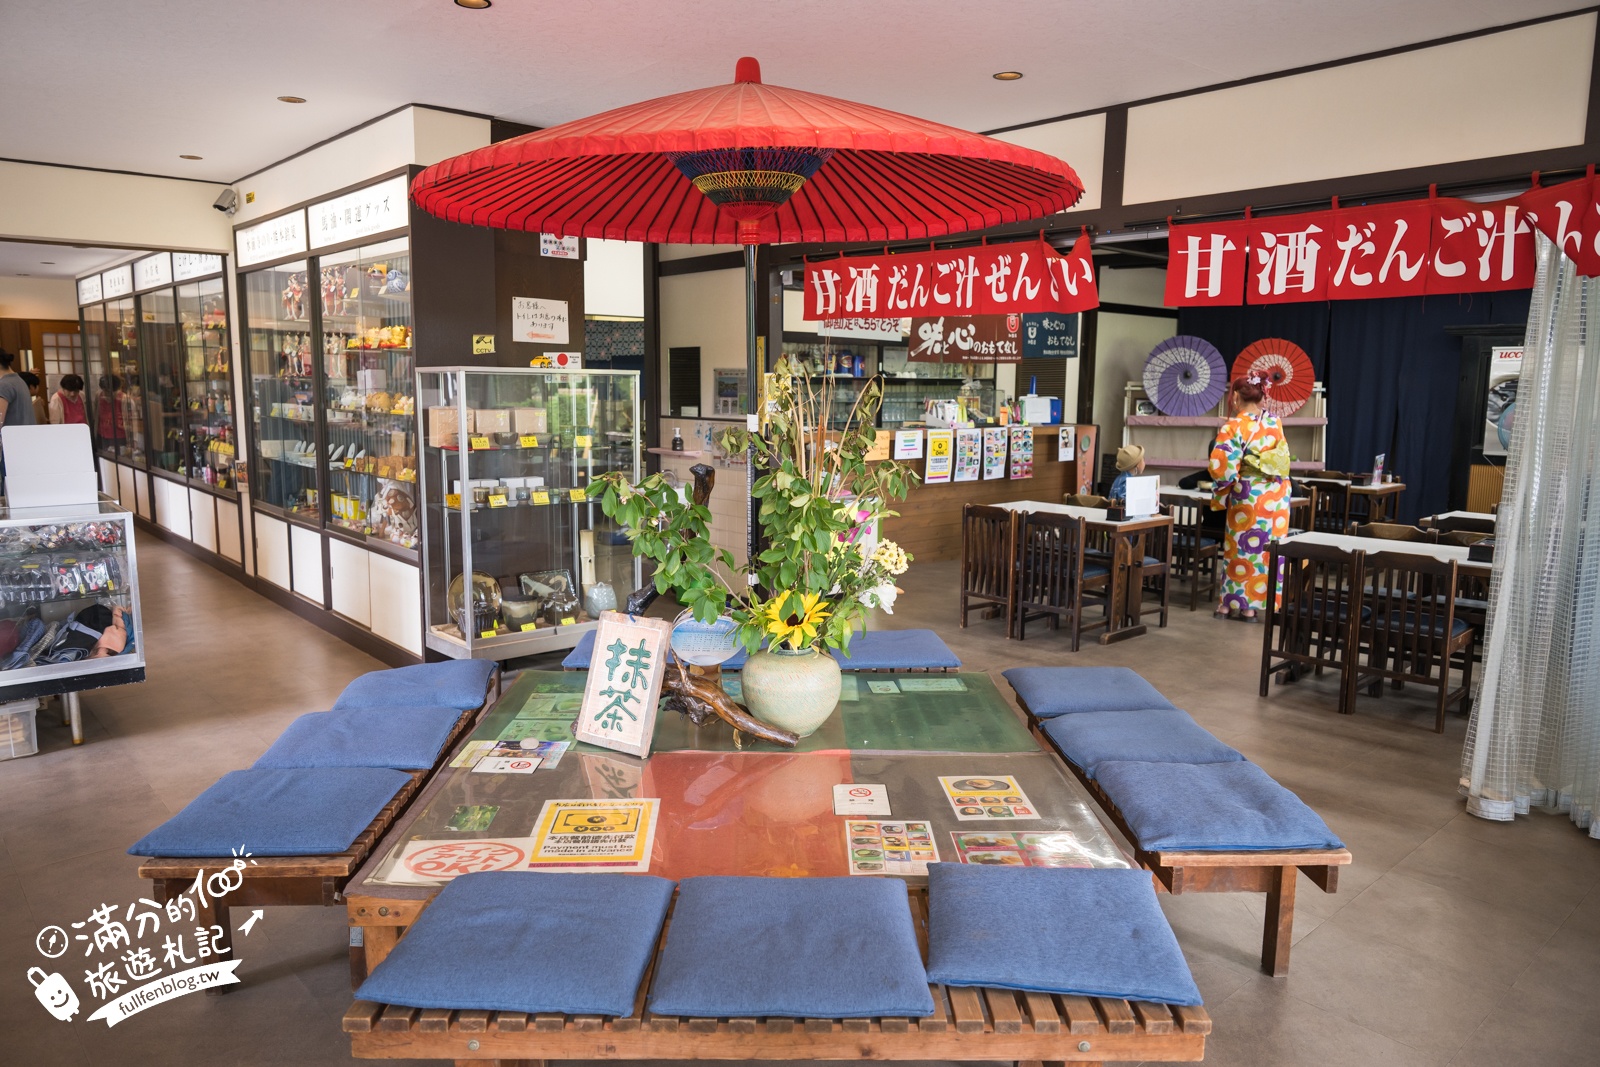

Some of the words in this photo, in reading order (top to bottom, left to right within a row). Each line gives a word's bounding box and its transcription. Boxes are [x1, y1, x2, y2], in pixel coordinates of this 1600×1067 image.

[1177, 200, 1600, 298] 甘酒だんご汁ん
[910, 316, 1018, 357] 味と心のおもてなし
[1046, 335, 1076, 347] おもてなし
[1499, 351, 1524, 359] UCC
[594, 638, 652, 732] 抹茶
[426, 852, 503, 864] アウト
